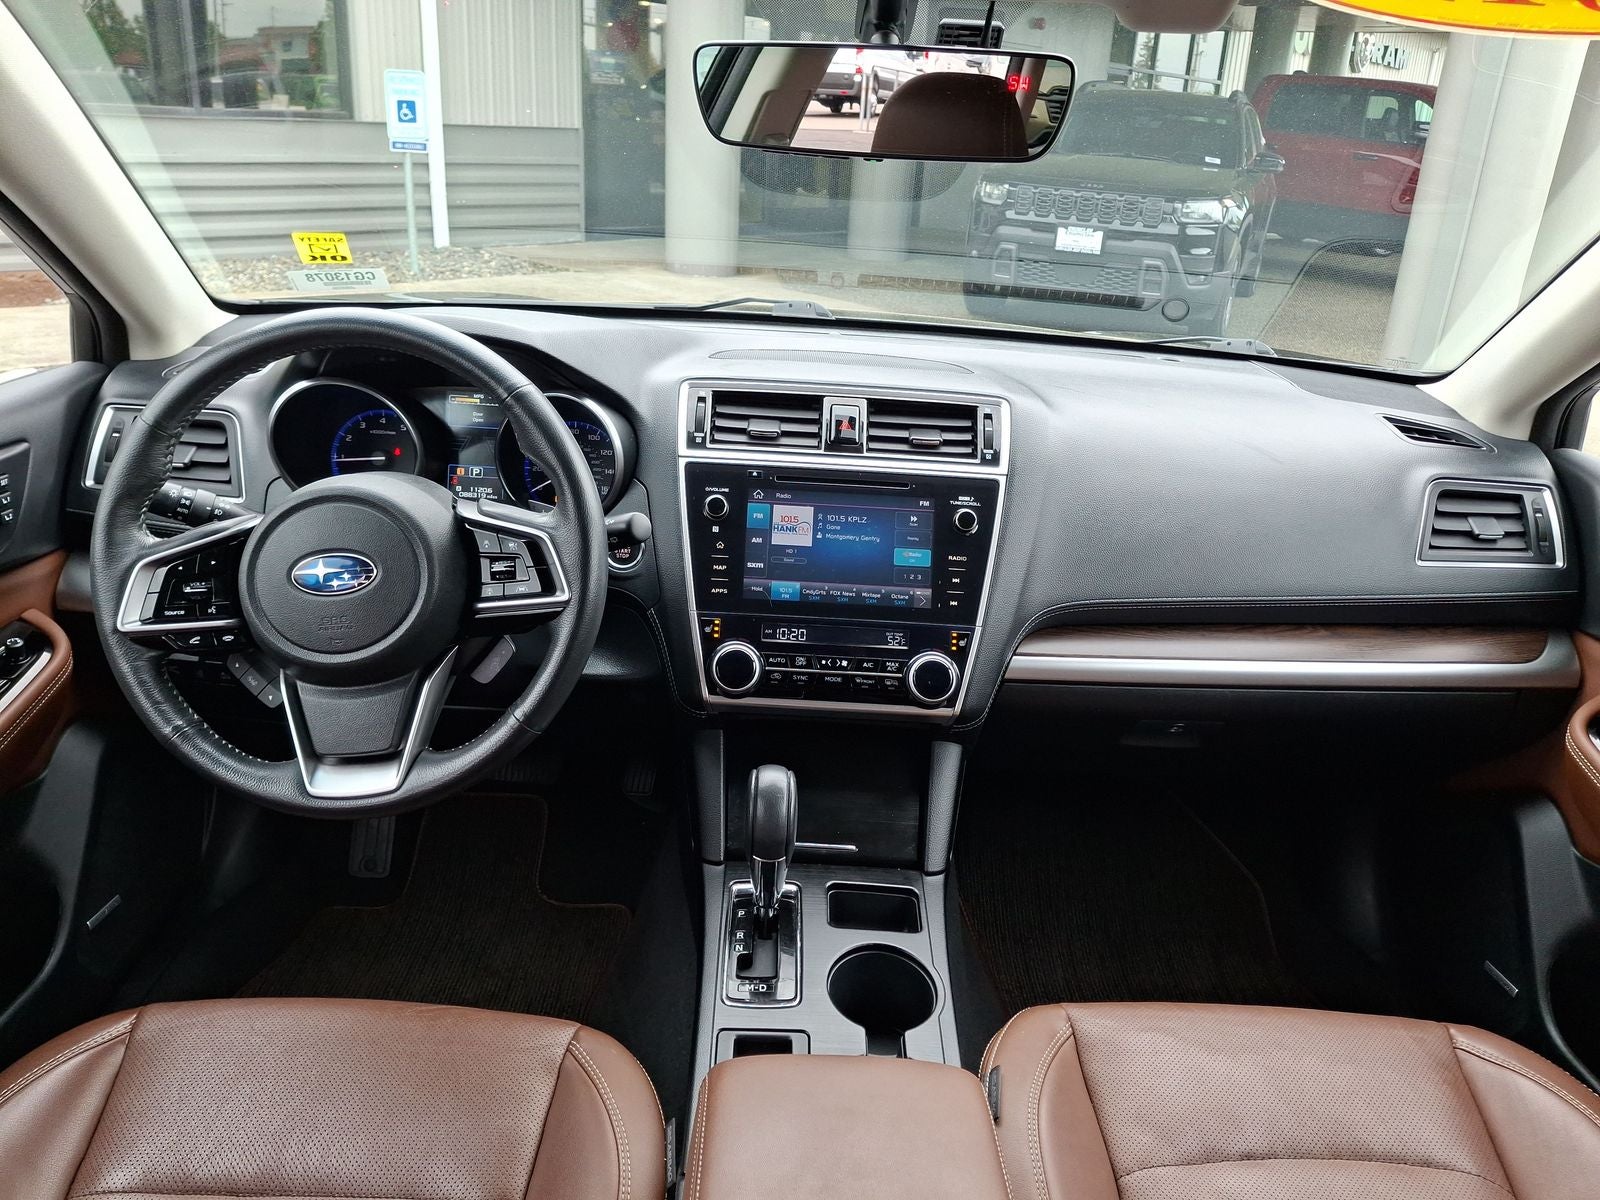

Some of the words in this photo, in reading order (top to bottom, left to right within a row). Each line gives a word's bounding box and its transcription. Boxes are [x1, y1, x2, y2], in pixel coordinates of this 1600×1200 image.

[1369, 43, 1409, 70] RAM
[1008, 75, 1029, 91] SW
[359, 421, 367, 429] 3
[345, 434, 353, 442] 2
[472, 468, 481, 477] P
[779, 515, 800, 524] 101.5
[826, 514, 846, 523] 101.5
[847, 515, 868, 524] KPLZ
[825, 532, 860, 542] Montgomery
[860, 534, 881, 543] Gentry
[861, 592, 881, 600] Mixtape
[776, 628, 807, 641] 10:20
[768, 656, 786, 664] AUTO
[738, 910, 745, 918] P
[735, 944, 743, 952] N
